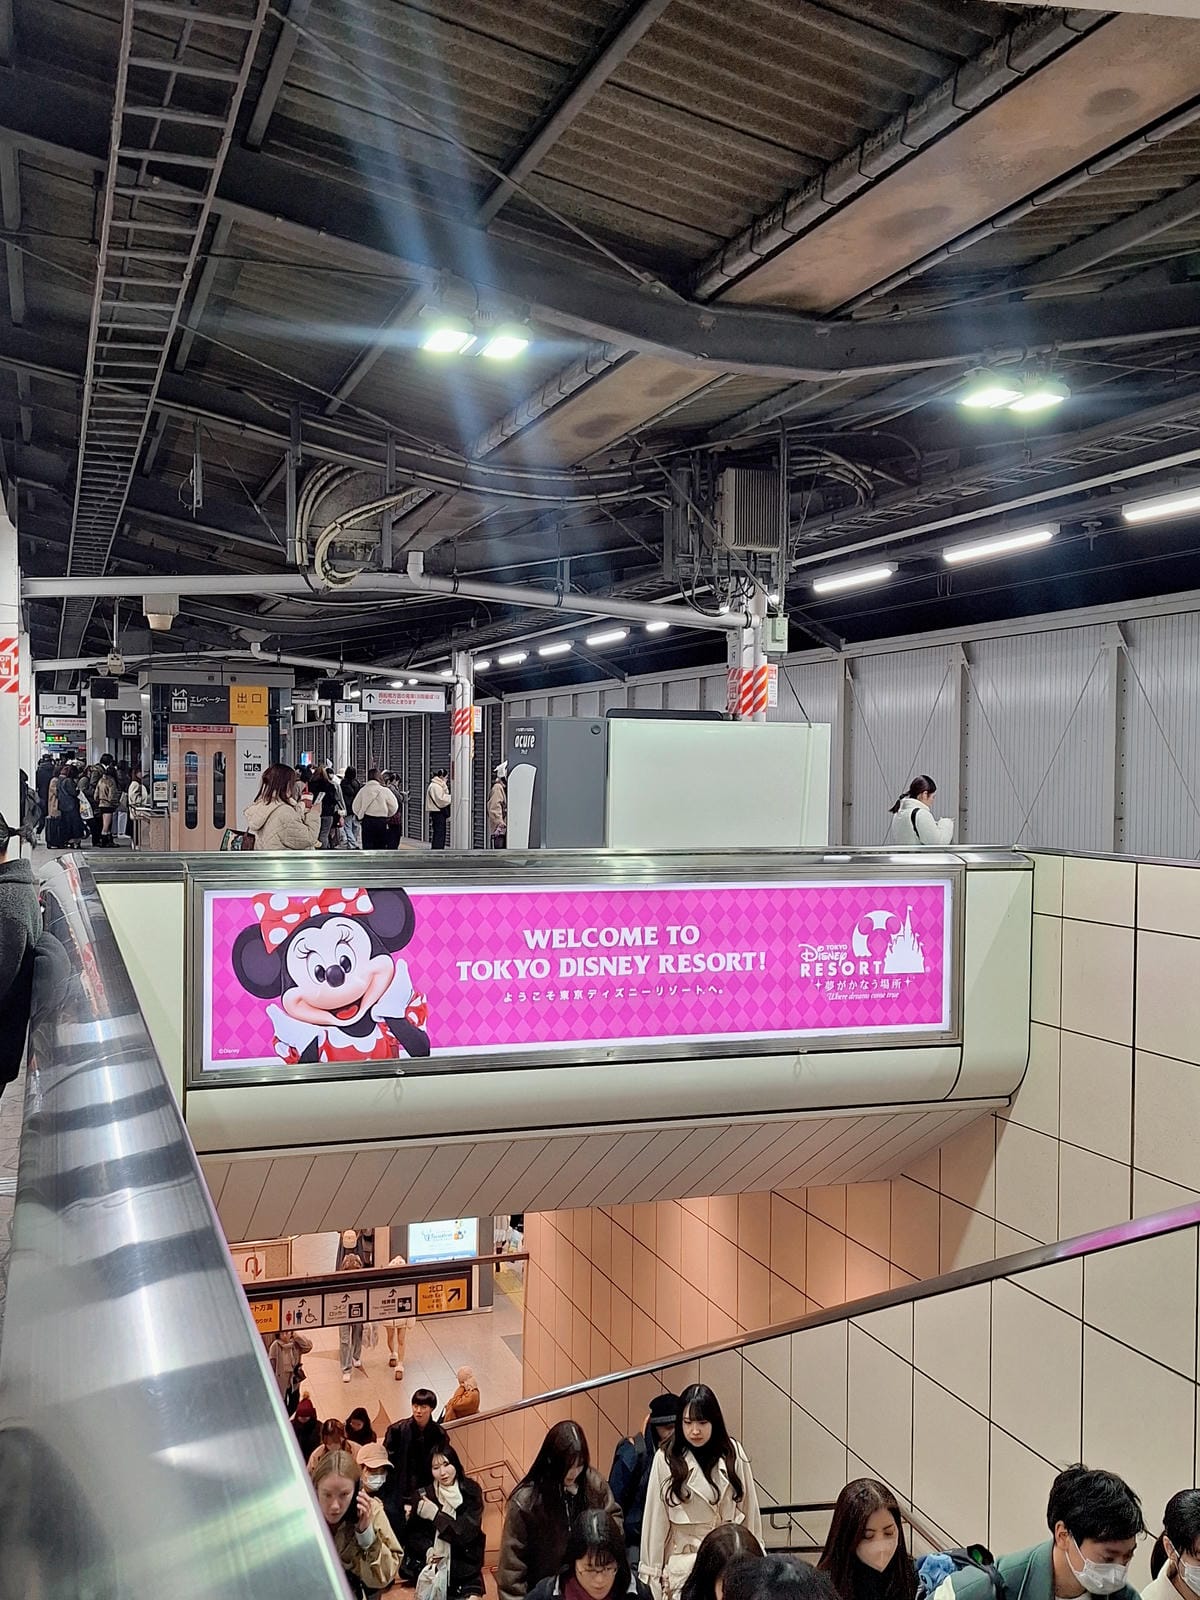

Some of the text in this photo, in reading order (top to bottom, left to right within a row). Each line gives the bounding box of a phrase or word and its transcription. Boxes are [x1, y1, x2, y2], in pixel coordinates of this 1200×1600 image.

[190, 696, 227, 704] エレベーター
[237, 693, 262, 704] 出口
[514, 735, 536, 748] acure
[523, 925, 700, 950] WELCOME TO
[456, 951, 767, 982] TOKYO DISNEY RESORT!
[800, 960, 883, 978] RESORT
[824, 978, 902, 992] 夢がかなう場所
[503, 985, 724, 1003] ようこそ東京ディズニーリゾートへ。
[827, 993, 848, 1001] Where
[429, 1284, 444, 1293] 北口
